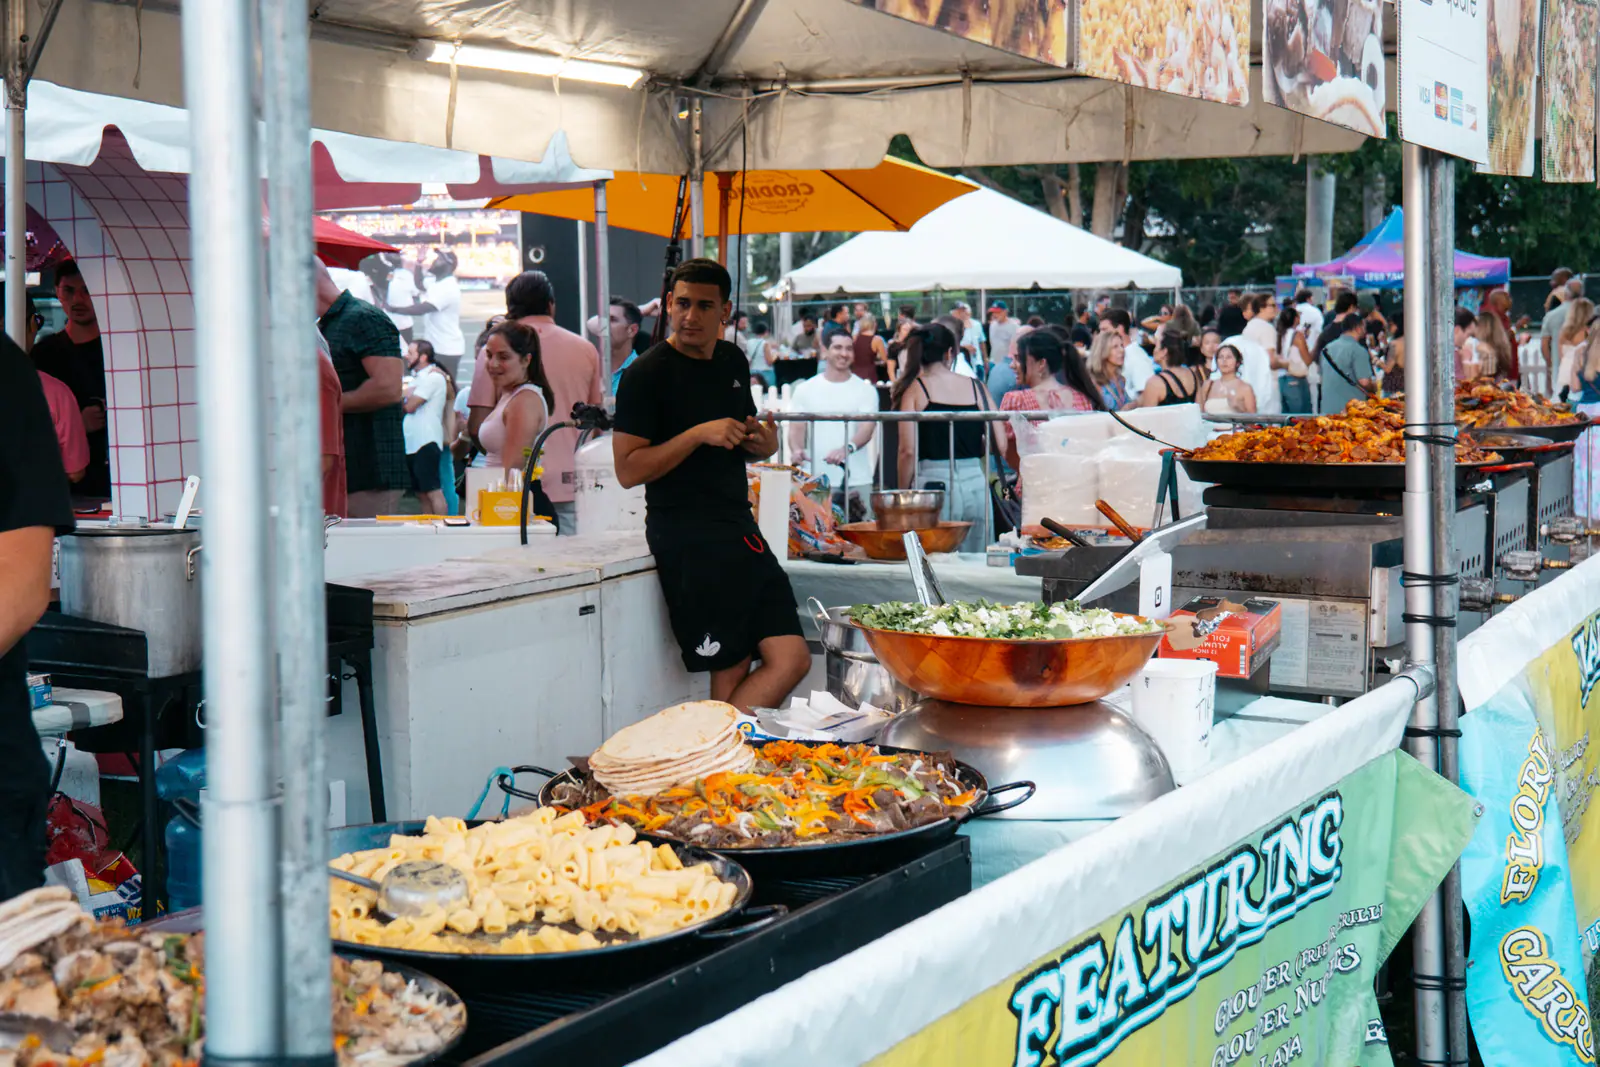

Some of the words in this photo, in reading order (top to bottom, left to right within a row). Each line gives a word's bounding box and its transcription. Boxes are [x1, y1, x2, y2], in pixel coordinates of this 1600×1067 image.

[1211, 634, 1231, 643] FOIL
[1008, 789, 1344, 1067] FEATURING
[1214, 961, 1292, 1035] GOUER
[1502, 927, 1596, 1060] CARR
[1211, 1003, 1290, 1067] GOUER
